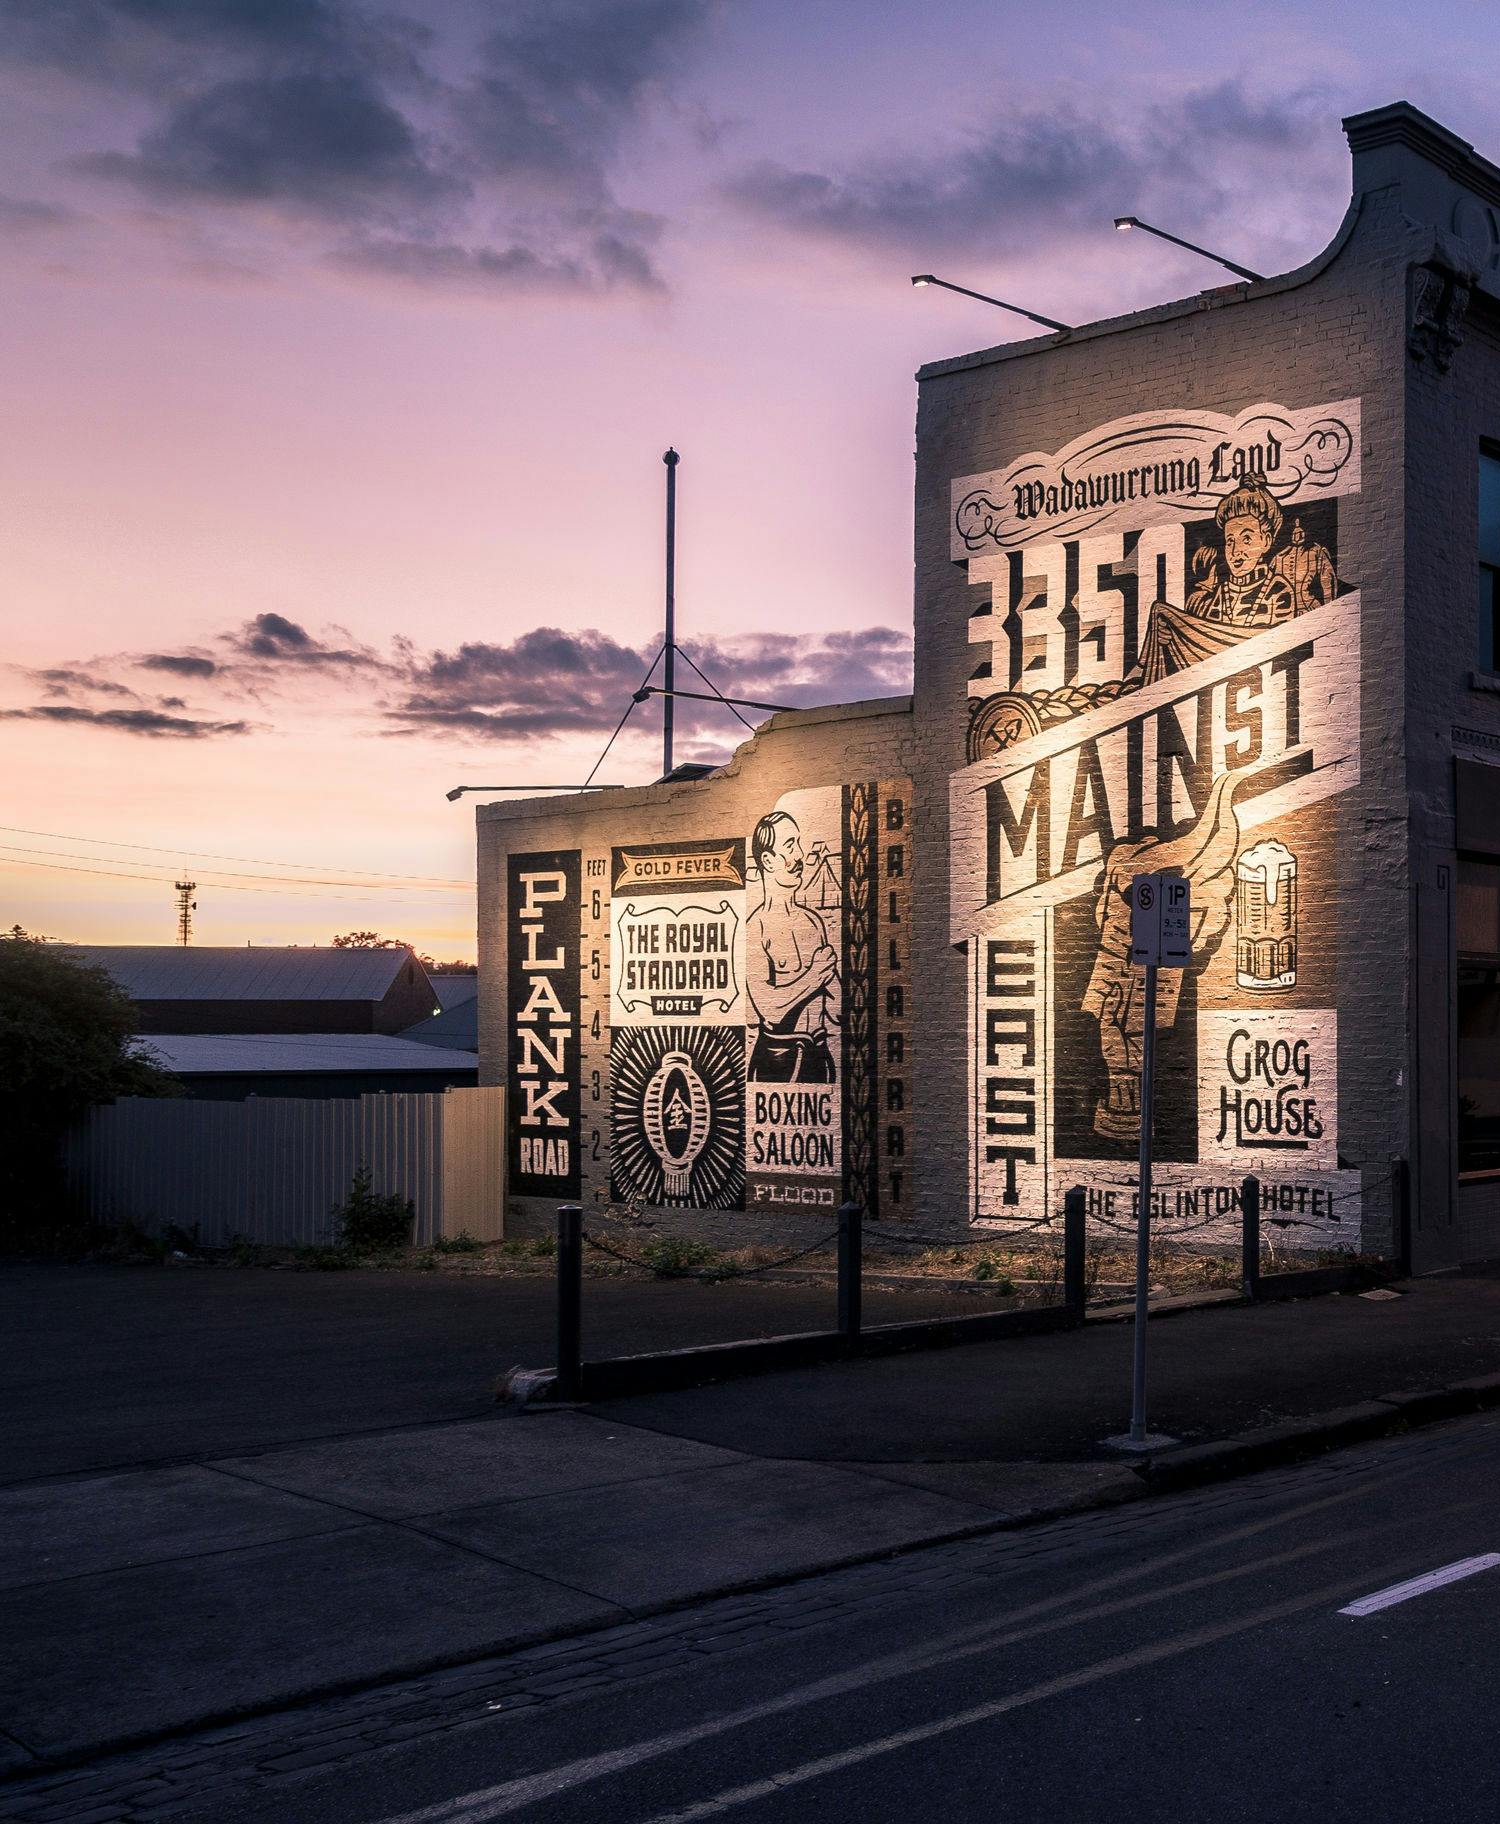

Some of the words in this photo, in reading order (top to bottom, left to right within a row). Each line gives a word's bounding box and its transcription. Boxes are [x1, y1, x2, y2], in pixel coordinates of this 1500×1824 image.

[1012, 456, 1200, 520] Wadawurrung
[1207, 430, 1282, 488] Land
[966, 523, 1188, 700] 3350
[984, 690, 1214, 911] MAIN
[1222, 638, 1314, 776] ST
[587, 860, 606, 876] FEET
[634, 861, 671, 876] GOLD
[676, 858, 721, 874] FEVER
[592, 890, 600, 919] 6
[1168, 884, 1186, 906] 1P
[627, 924, 659, 953] THE
[666, 923, 728, 953] ROYAL
[592, 950, 600, 980] 5
[627, 959, 728, 990] STANDARD
[517, 871, 571, 1127] PLANK
[656, 1000, 697, 1012] HOTEL
[591, 1011, 600, 1041] 4
[592, 1070, 600, 1101] 3
[986, 940, 1036, 1206] EAST
[755, 1092, 832, 1126] BOXING
[520, 1137, 570, 1177] ROAD
[592, 1129, 600, 1161] 2
[753, 1131, 834, 1167] SALOON
[753, 1183, 835, 1205] FLOOD
[1080, 1187, 1117, 1218] HE
[1261, 1184, 1341, 1222] HOTEL
